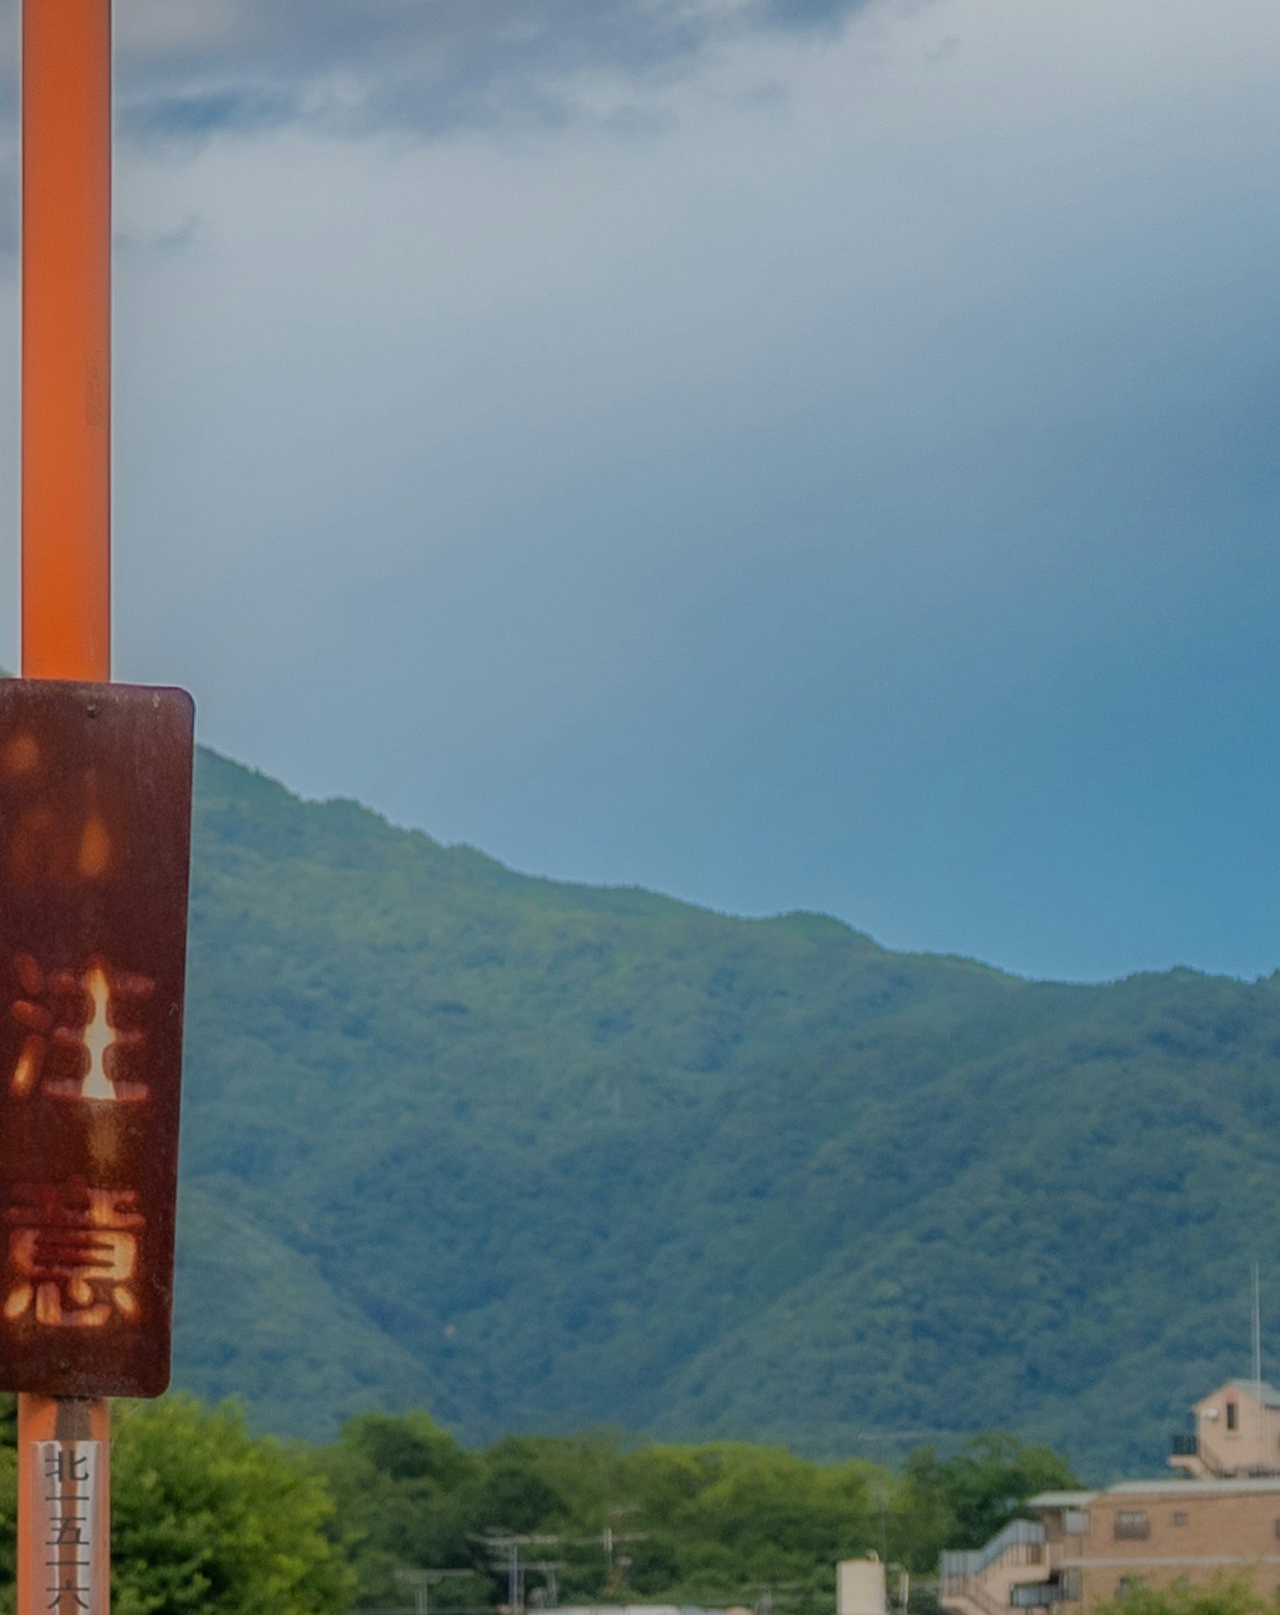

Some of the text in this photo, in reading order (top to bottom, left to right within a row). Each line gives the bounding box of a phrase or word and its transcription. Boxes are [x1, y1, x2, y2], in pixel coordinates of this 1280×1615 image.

[4, 954, 157, 1329] 注意
[45, 1450, 90, 1610] 北一五一六
